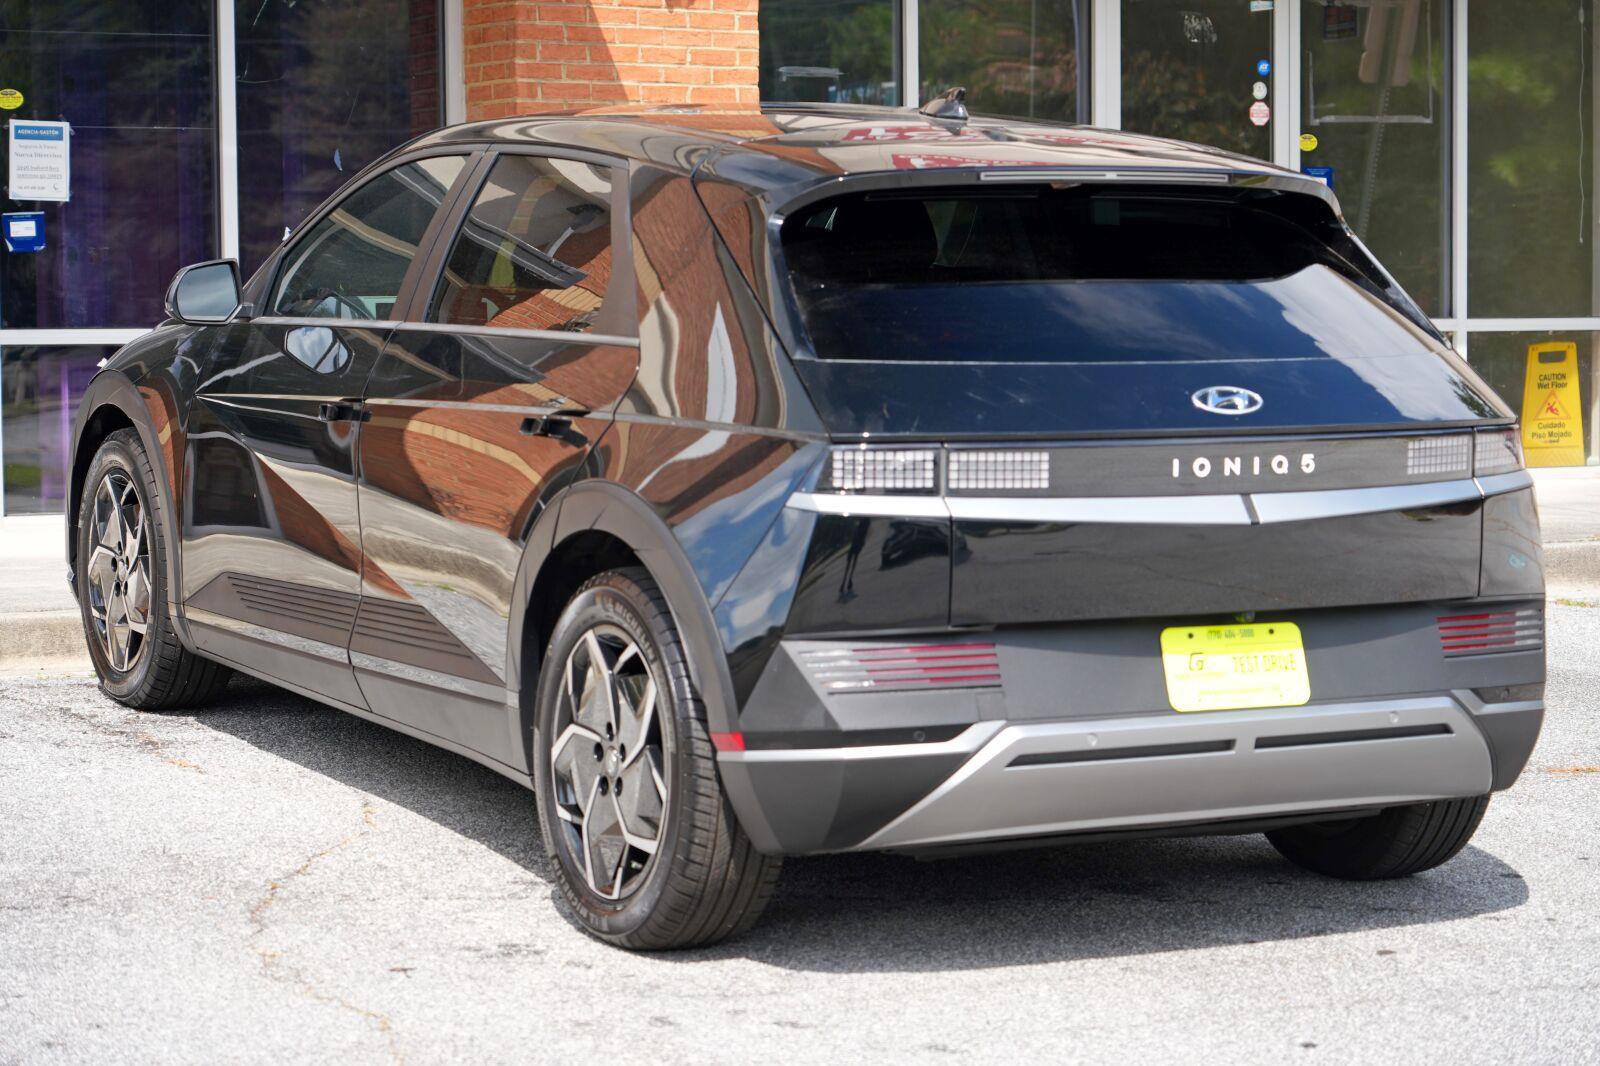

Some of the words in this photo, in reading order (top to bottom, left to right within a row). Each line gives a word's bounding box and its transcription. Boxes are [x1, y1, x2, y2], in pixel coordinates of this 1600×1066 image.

[1538, 373, 1567, 382] CAUTION
[1537, 382, 1550, 390] Wet
[1551, 381, 1568, 389] Floor
[1537, 421, 1566, 430] Cuidado
[1531, 431, 1546, 440] Piso
[1547, 430, 1573, 441] Mojado
[1232, 655, 1259, 673] TEST
